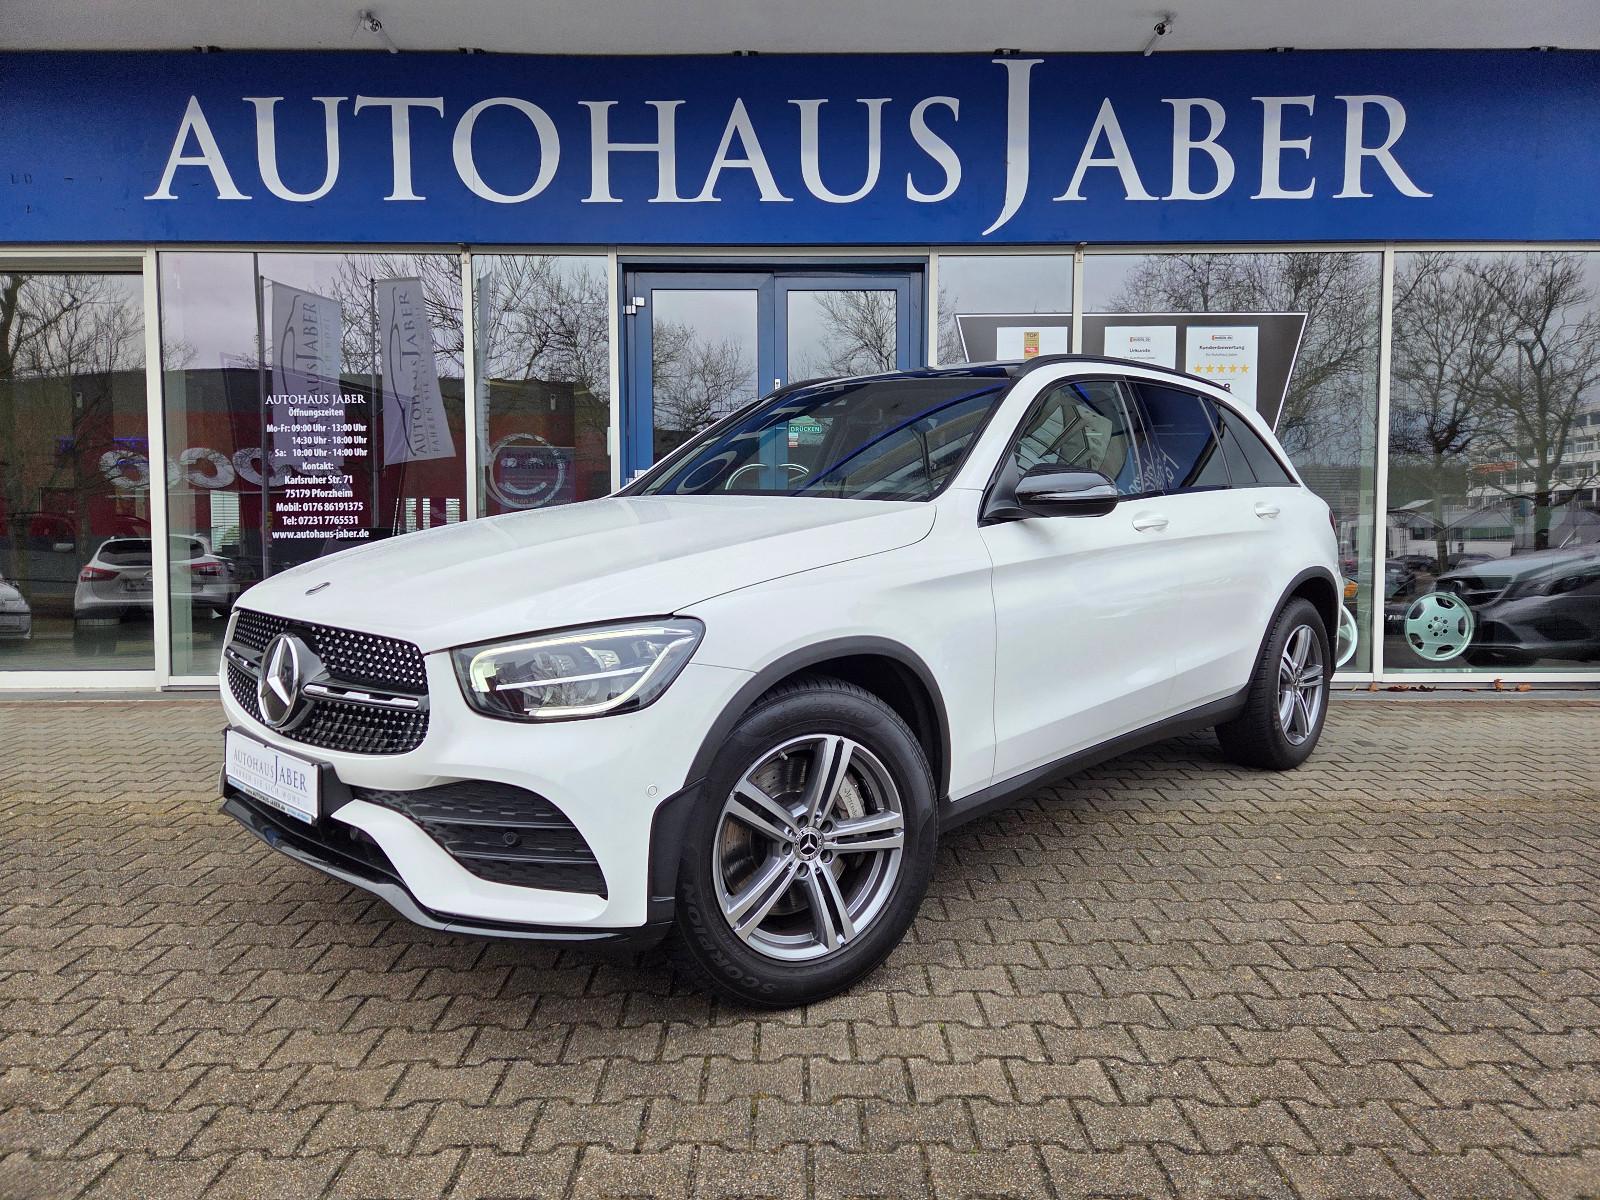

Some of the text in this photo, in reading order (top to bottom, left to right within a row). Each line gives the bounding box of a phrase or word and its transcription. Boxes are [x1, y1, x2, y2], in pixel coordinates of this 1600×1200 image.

[399, 292, 422, 359] JABER
[295, 302, 324, 362] JABER
[265, 394, 367, 406] AUTOHAUS JABER
[288, 406, 345, 418] Öffnungszeiten
[266, 423, 291, 433] Mo-Fr:
[291, 423, 312, 432] 09:00
[312, 423, 327, 432] Uhr
[331, 423, 352, 432] 13:00
[353, 423, 367, 431] Uhr
[292, 436, 312, 445] 14:30
[313, 436, 327, 444] Uhr
[332, 436, 352, 444] 18:00
[353, 435, 368, 444] Uhr
[274, 448, 287, 457] Sa:
[292, 448, 313, 457] 10:00
[314, 448, 328, 457] Uhr
[332, 448, 353, 456] 14:00
[354, 448, 368, 456] Uhr
[302, 461, 335, 470] Kontakt:
[284, 475, 353, 484] Karlsruher Str. 71
[285, 489, 353, 498] 75179 Pforzheim
[275, 502, 364, 512] Mobil: 0176 86191375
[282, 516, 359, 526] Tel: 07231 7765531
[271, 528, 370, 539] www.autohaus-jaber.de
[233, 748, 308, 793] AUTOHAUS JABER
[681, 881, 778, 994] SCORPION
